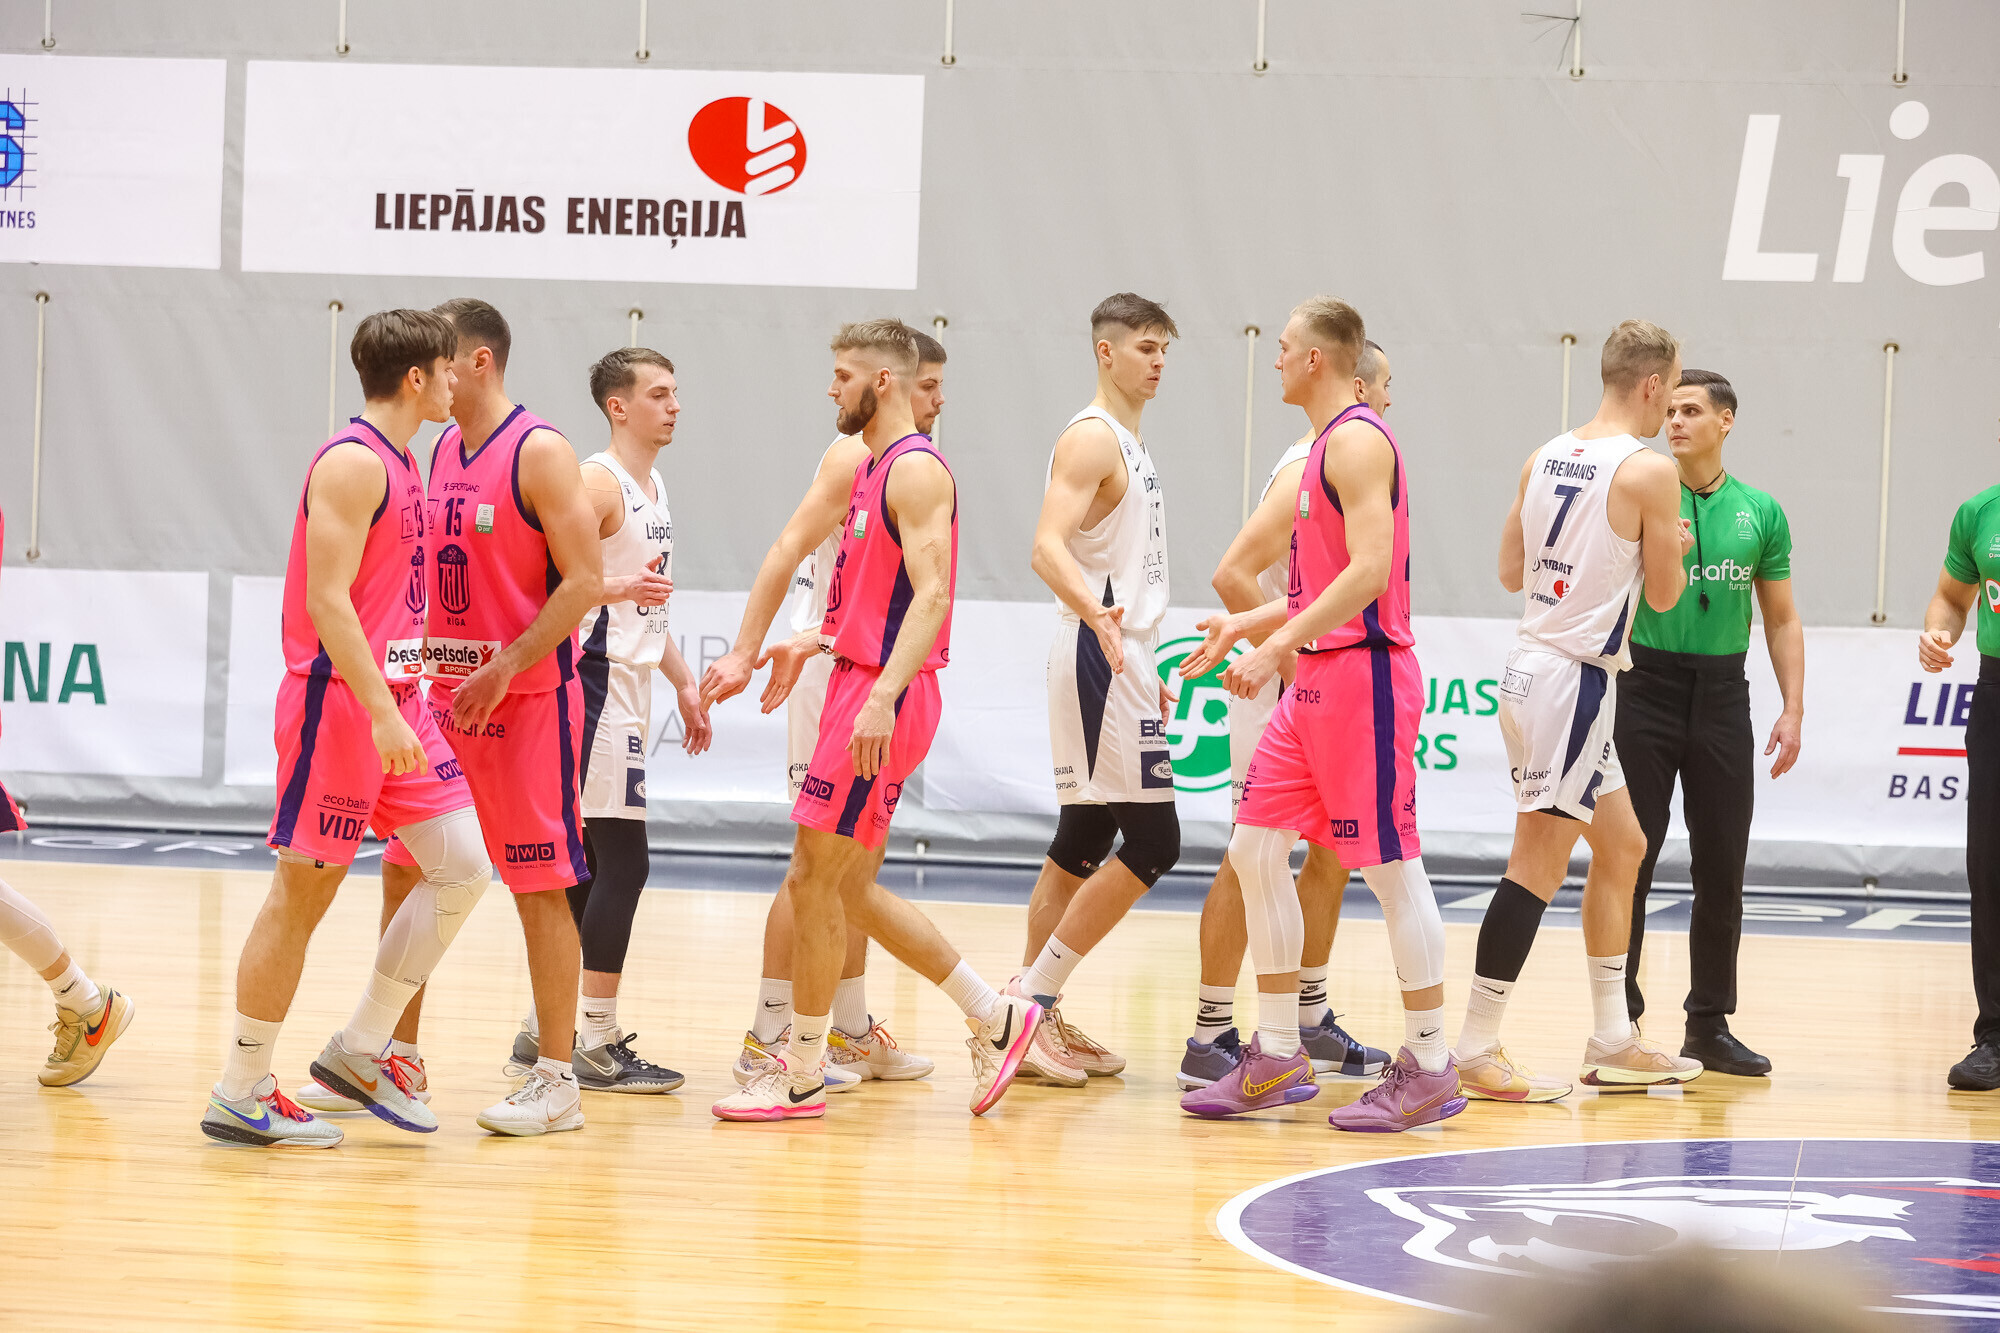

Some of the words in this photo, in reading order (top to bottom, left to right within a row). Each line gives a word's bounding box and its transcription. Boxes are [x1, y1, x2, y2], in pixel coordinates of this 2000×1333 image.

[1722, 101, 2000, 286] Lie
[375, 189, 546, 234] LIEPĀJAS
[566, 197, 746, 249] ENERĢIJA
[445, 498, 465, 537] 15
[1545, 484, 1583, 549] 7
[323, 793, 345, 806] eco
[505, 845, 553, 860] WWD
